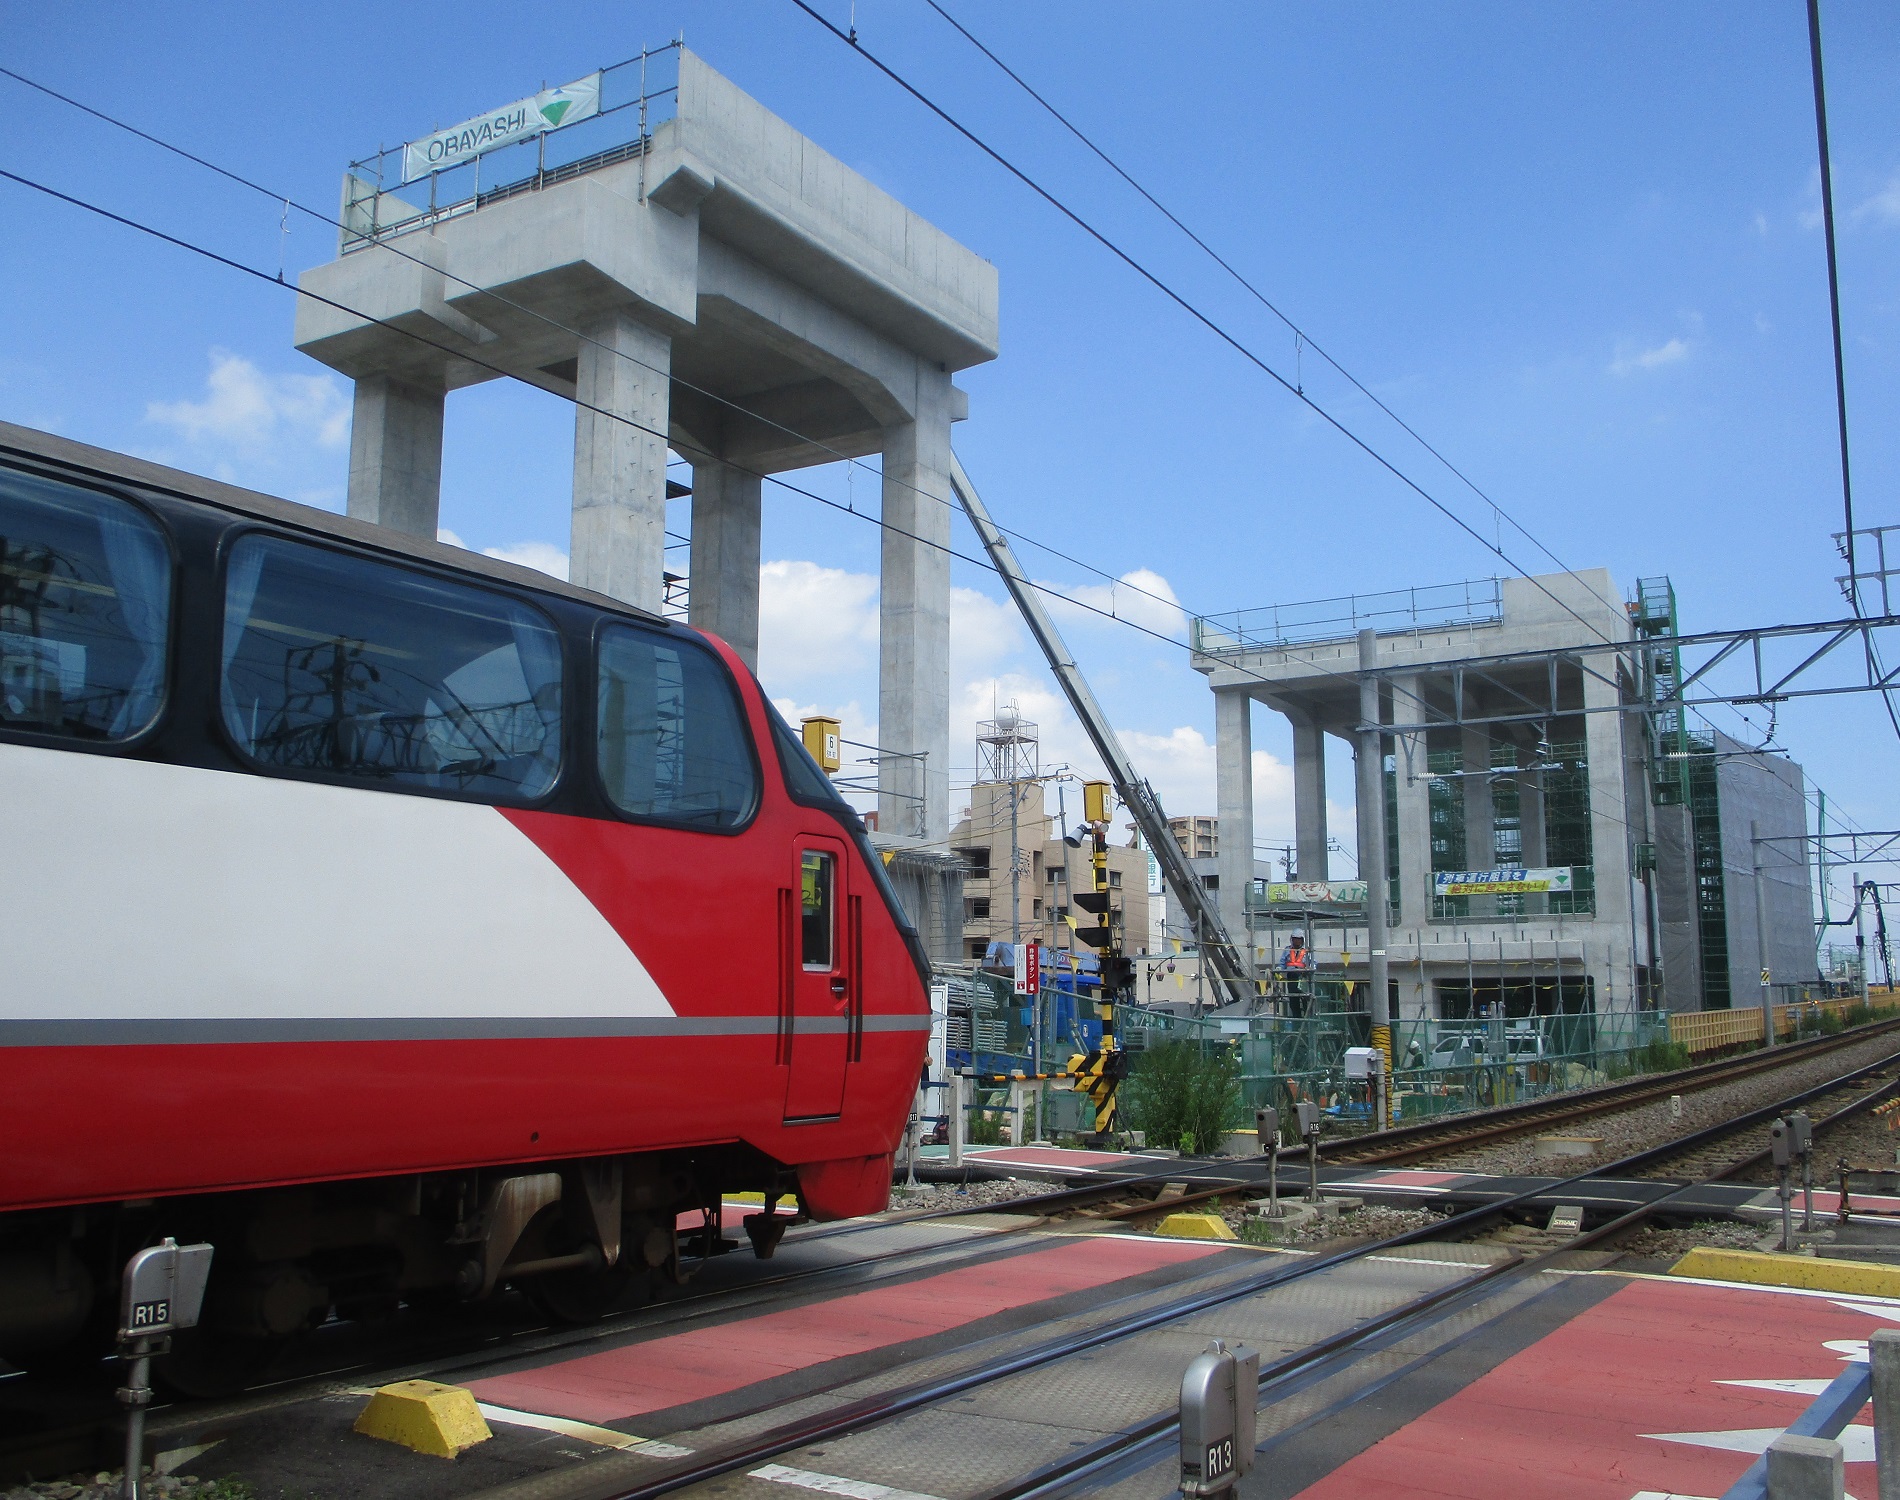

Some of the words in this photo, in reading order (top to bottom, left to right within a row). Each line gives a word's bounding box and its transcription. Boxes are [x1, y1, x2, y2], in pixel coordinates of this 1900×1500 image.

[429, 108, 526, 162] OBAYASHI
[135, 1303, 167, 1324] R15
[1208, 1440, 1232, 1477] R13
